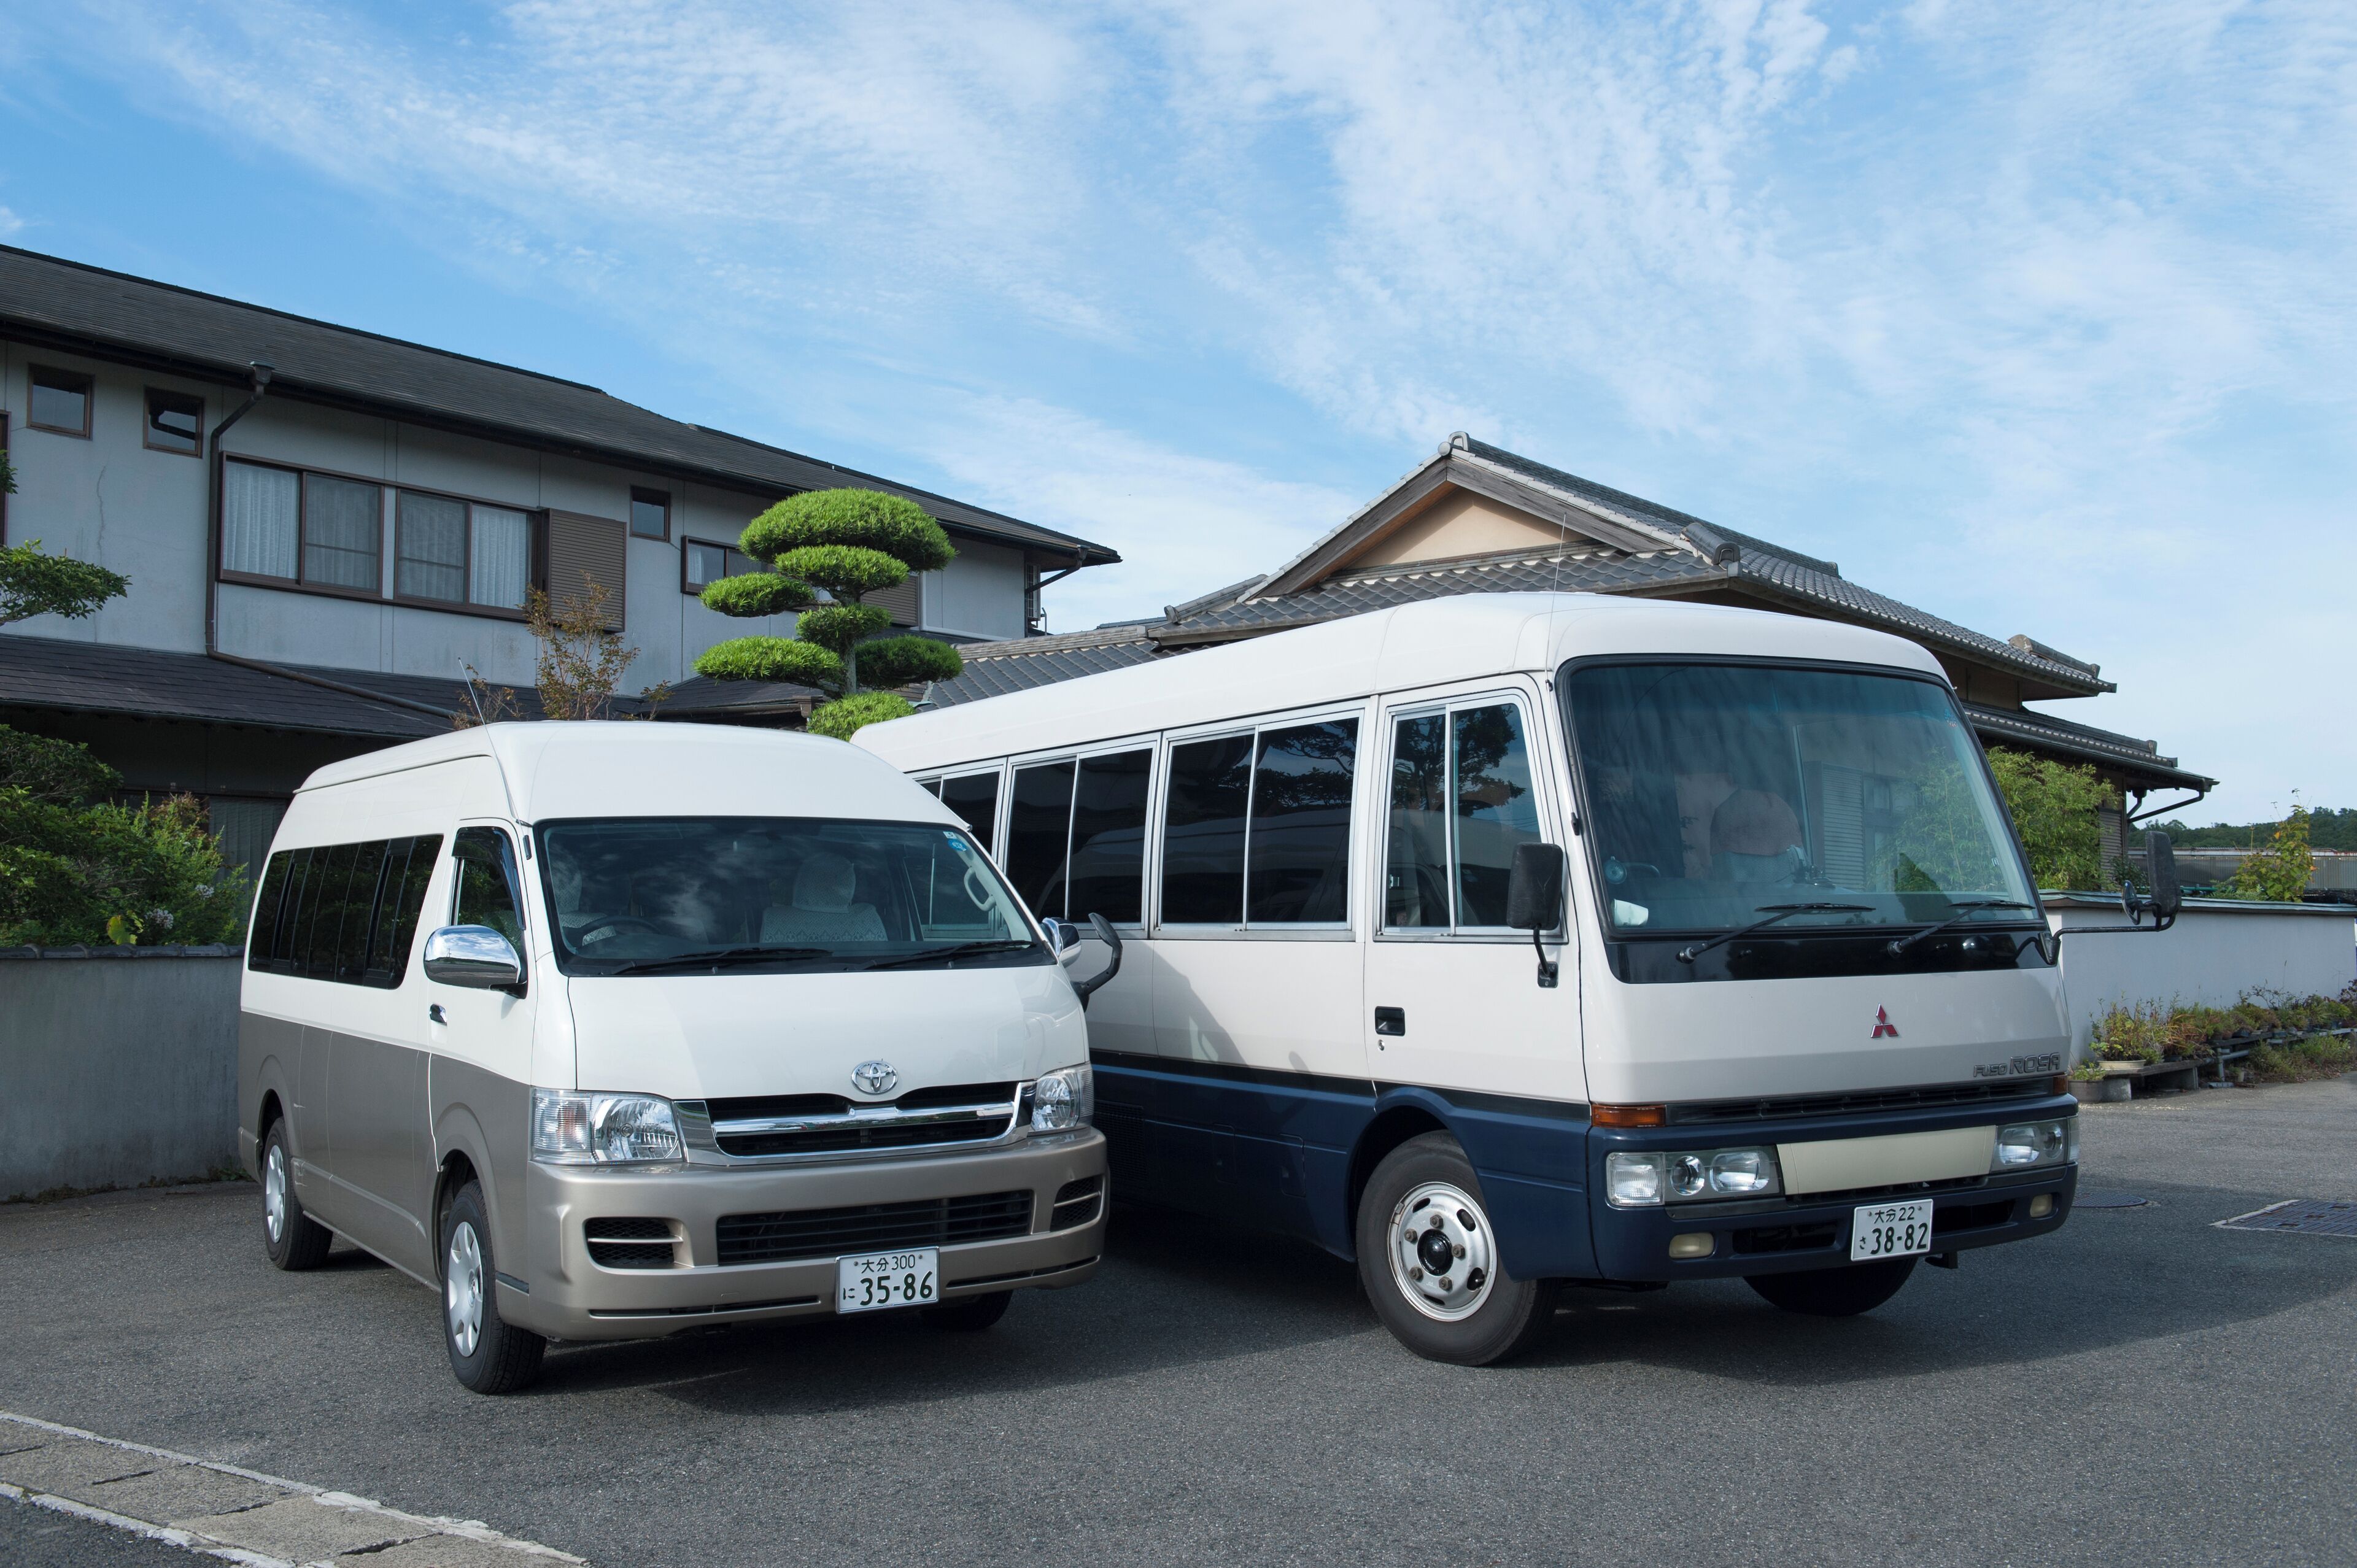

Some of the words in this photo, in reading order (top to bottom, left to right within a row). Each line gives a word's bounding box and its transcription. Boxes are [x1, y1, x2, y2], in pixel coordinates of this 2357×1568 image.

[1973, 1063, 2008, 1078] FUSO
[2010, 1052, 2061, 1075] ROSA
[1870, 1222, 1928, 1254] 38-82
[843, 1288, 855, 1300] に
[860, 1271, 933, 1306] 35-86
